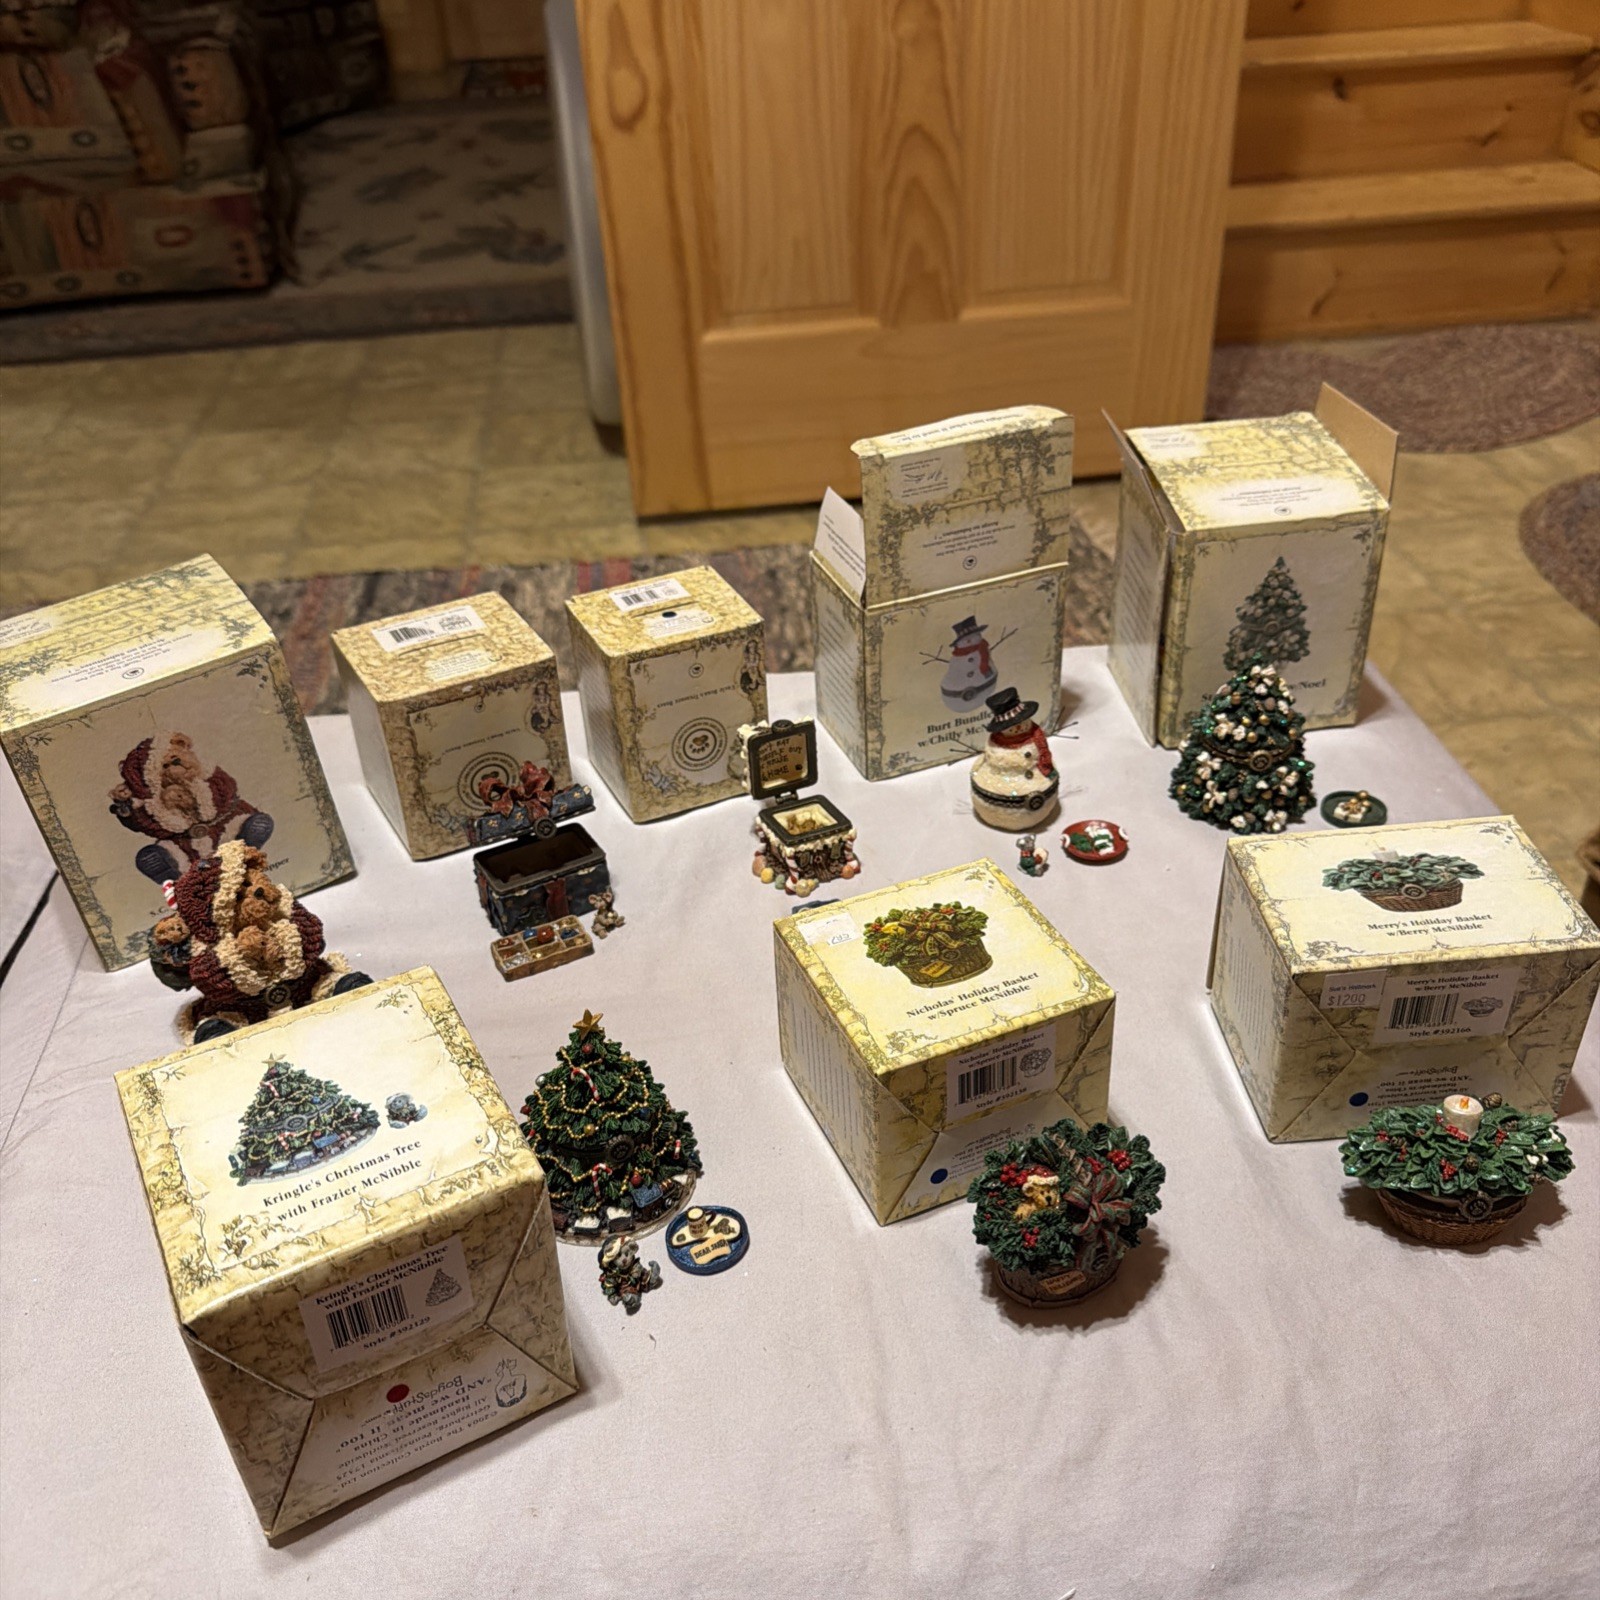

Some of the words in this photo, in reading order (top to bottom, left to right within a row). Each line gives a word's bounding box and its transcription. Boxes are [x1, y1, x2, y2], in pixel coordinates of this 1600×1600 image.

[927, 721, 951, 734] Burt
[955, 710, 993, 727] Bundle
[1368, 920, 1408, 930] Merry's
[1410, 917, 1453, 927] Holiday
[1455, 914, 1493, 922] Basket
[1386, 928, 1429, 937] w/Berry
[1432, 923, 1484, 933] McNibble
[1448, 981, 1487, 989] McNibble
[906, 996, 955, 1018] Nicholas'
[958, 983, 1000, 1002] Holiday
[1002, 971, 1039, 988] Basket
[927, 1001, 978, 1021] w/Spruce
[979, 984, 1031, 1005] McNibble
[1408, 1030, 1431, 1038] Style
[263, 1180, 322, 1207] Kringle's
[325, 1154, 391, 1183] Christmas
[393, 1140, 422, 1157] Tree
[277, 1204, 307, 1222] with
[310, 1185, 358, 1209] Frazier
[360, 1159, 422, 1190] McNibble
[694, 1246, 711, 1259] DEAR
[316, 1280, 364, 1305] Kringle's
[366, 1256, 422, 1283] Christmas
[424, 1245, 448, 1259] Tree
[324, 1296, 350, 1311] with
[353, 1279, 390, 1298] Frazier
[393, 1256, 445, 1282] McNibble
[363, 1336, 387, 1349] Style
[432, 1394, 450, 1407] we
[474, 1395, 488, 1406] All
[408, 1394, 470, 1427] Handmade
[442, 1404, 471, 1420] Rights
[371, 1425, 381, 1435] it
[392, 1425, 404, 1434] in
[395, 1418, 439, 1443] Reserved
[446, 1427, 464, 1438] The
[354, 1433, 388, 1452] China
[370, 1432, 433, 1460] Pennsylvania
[414, 1436, 443, 1454] Boyds
[338, 1441, 390, 1469] Worldwide
[366, 1451, 412, 1476] Collection
